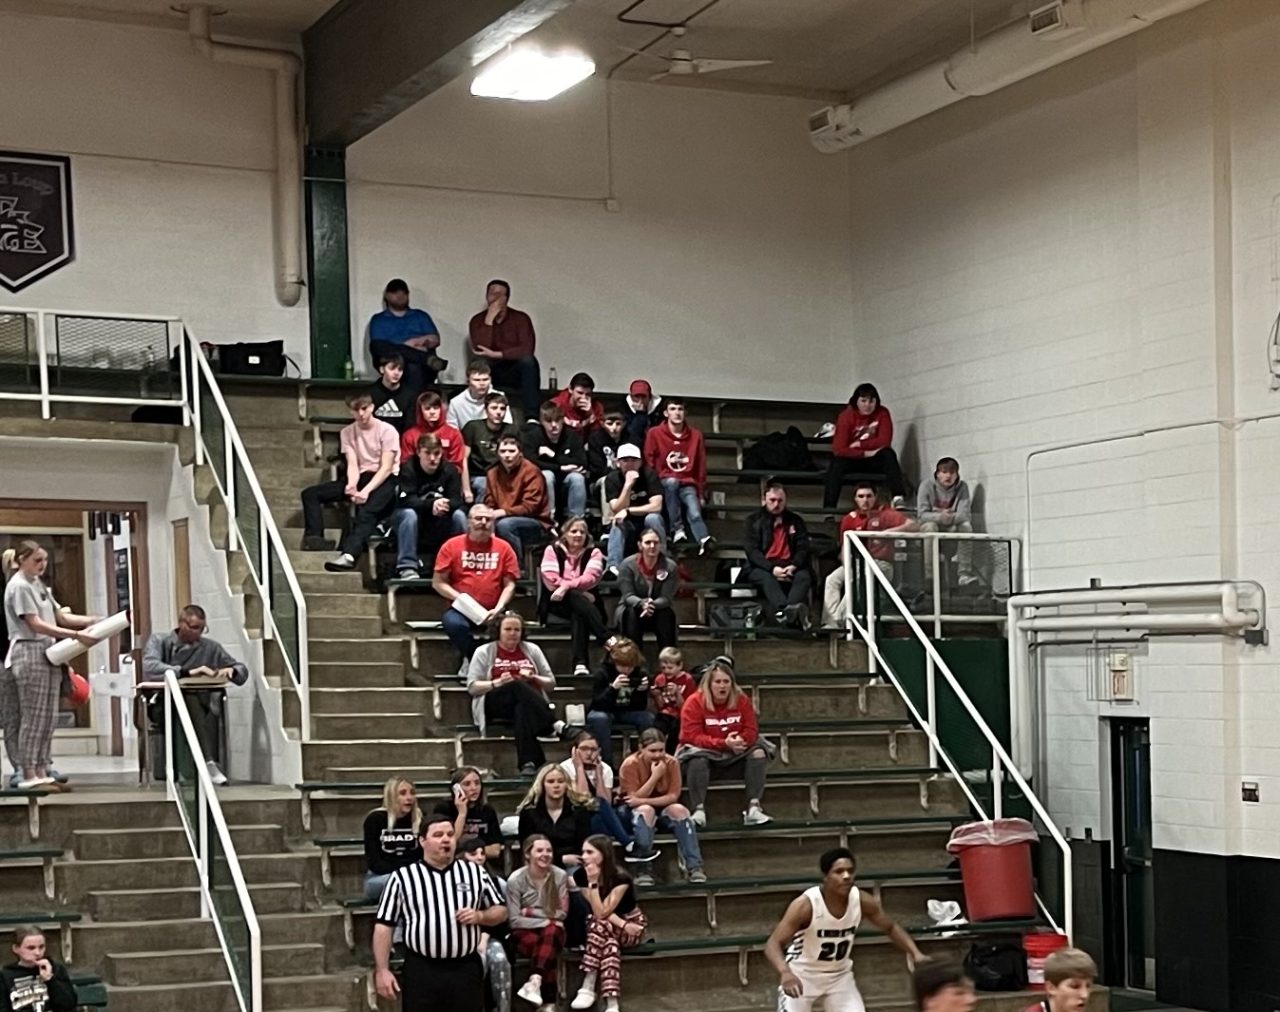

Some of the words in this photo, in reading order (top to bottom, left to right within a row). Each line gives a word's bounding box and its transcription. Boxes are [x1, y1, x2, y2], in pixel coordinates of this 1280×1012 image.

[461, 550, 500, 561] EAGLE
[462, 560, 498, 570] POWER
[817, 940, 850, 961] 20
